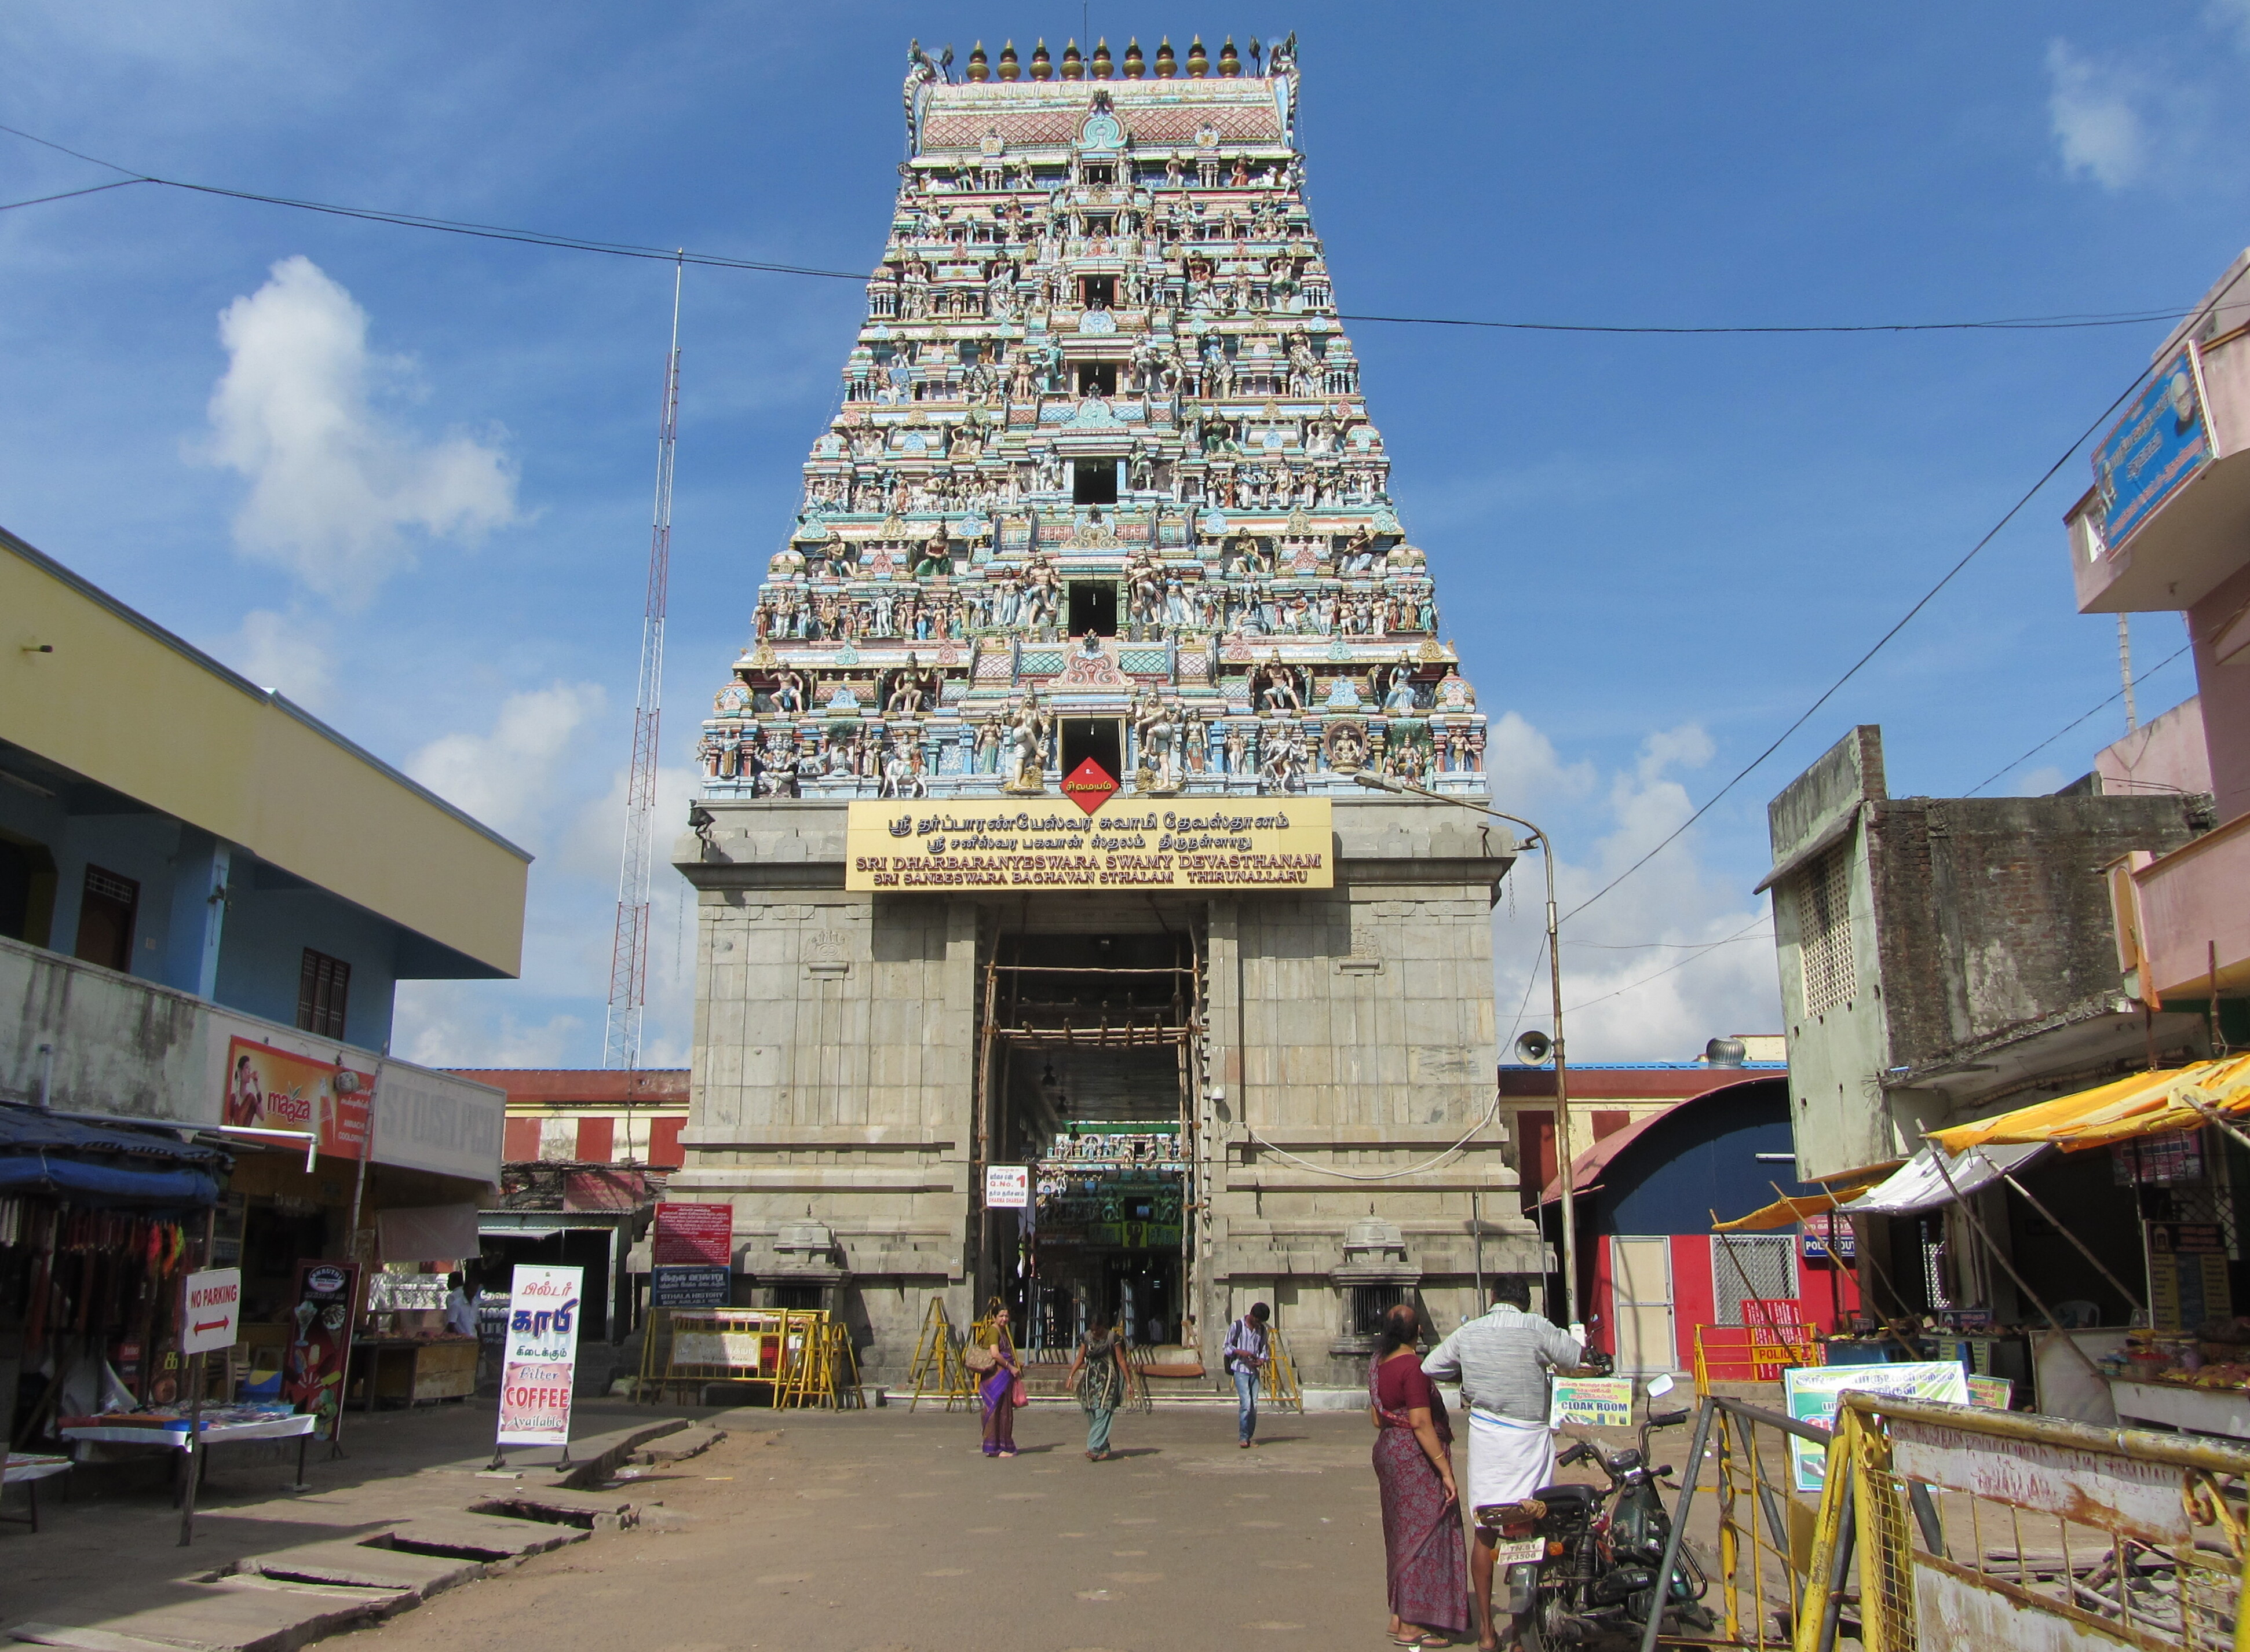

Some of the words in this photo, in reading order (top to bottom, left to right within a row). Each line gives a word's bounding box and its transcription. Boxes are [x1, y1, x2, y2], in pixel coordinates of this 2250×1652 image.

[1066, 780, 1112, 792] சிவமயம்
[1099, 812, 1158, 829] சுவாமி
[1163, 811, 1290, 833] தேவஸ்தானம்
[950, 835, 1018, 850] சனீஸ்வர
[1022, 834, 1084, 850] பகவான்
[1090, 834, 1146, 851] ஸ்தலம்
[1158, 833, 1253, 851] திருநள்ளாறு
[856, 856, 887, 872] SRI
[892, 855, 1100, 871] DHARBARANYESWARA
[1105, 854, 1174, 869] SWAMY
[1179, 853, 1321, 869] DEVASTHANAM
[873, 873, 899, 886] SRI
[904, 872, 1008, 885] SANEESWARA
[1012, 872, 1095, 885] BAGHAVAN
[1100, 871, 1174, 885] STHALAM
[1187, 871, 1308, 885] THIRUNALLARU
[266, 1089, 311, 1124] maaza
[1016, 1175, 1025, 1187] 1
[191, 1291, 202, 1309] NO
[203, 1284, 237, 1307] PARKING
[522, 1281, 572, 1297] பில்டர்
[516, 1346, 567, 1361] கிடைக்கும்
[519, 1366, 560, 1380] Filter
[505, 1387, 569, 1409] COFFEE
[1561, 1401, 1594, 1411] CLOAK
[1597, 1402, 1627, 1412] ROOM
[506, 1415, 562, 1429] Available
